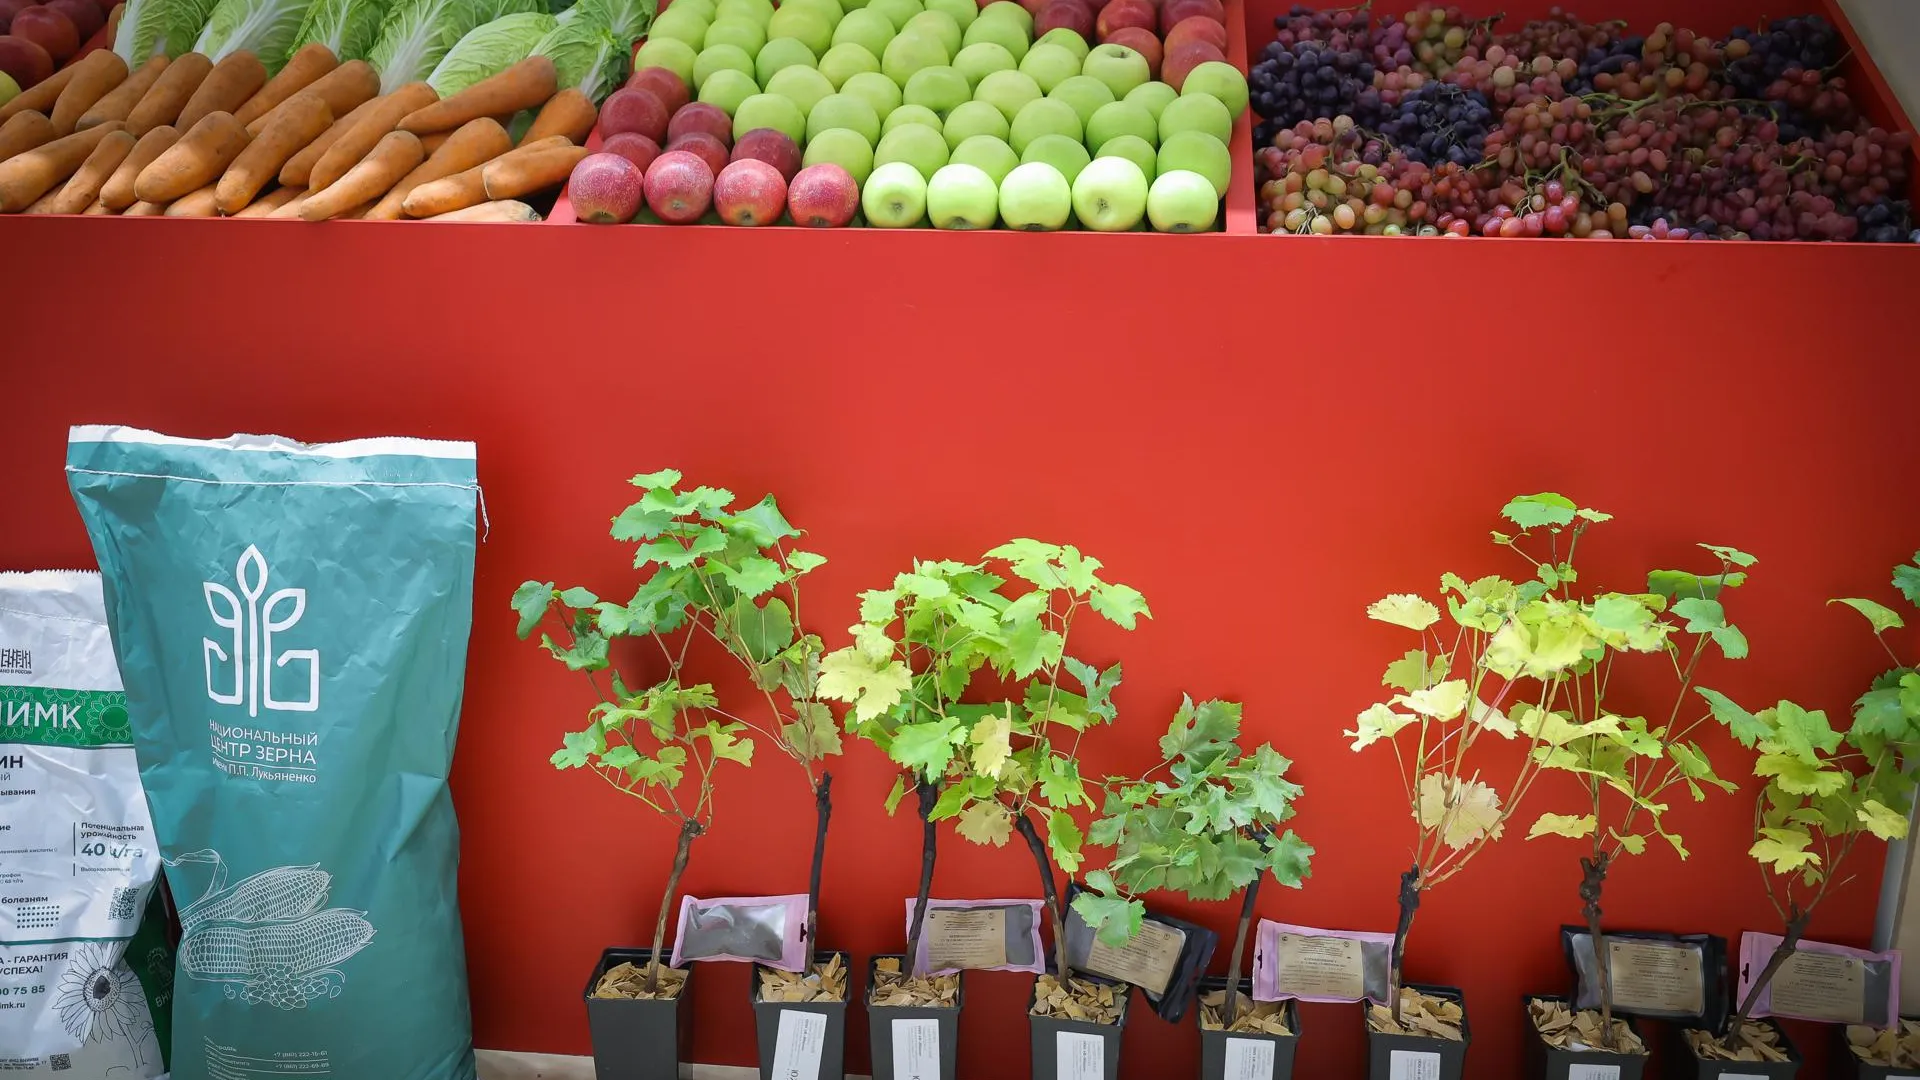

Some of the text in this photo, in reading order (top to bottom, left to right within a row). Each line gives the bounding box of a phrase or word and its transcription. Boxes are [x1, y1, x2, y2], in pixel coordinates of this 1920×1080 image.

[209, 719, 318, 746] НАЦИОНАЛЬНЫЙ
[210, 734, 317, 764] ЦЕНТР ЗЕРНА
[251, 766, 316, 783] Лукьяненко
[81, 822, 145, 832] Потенциальная
[81, 843, 106, 857] 40
[1, 896, 48, 904] болезням
[14, 952, 69, 964] ГАРАНТИЯ
[13, 986, 28, 996] 75
[31, 984, 46, 994] 85
